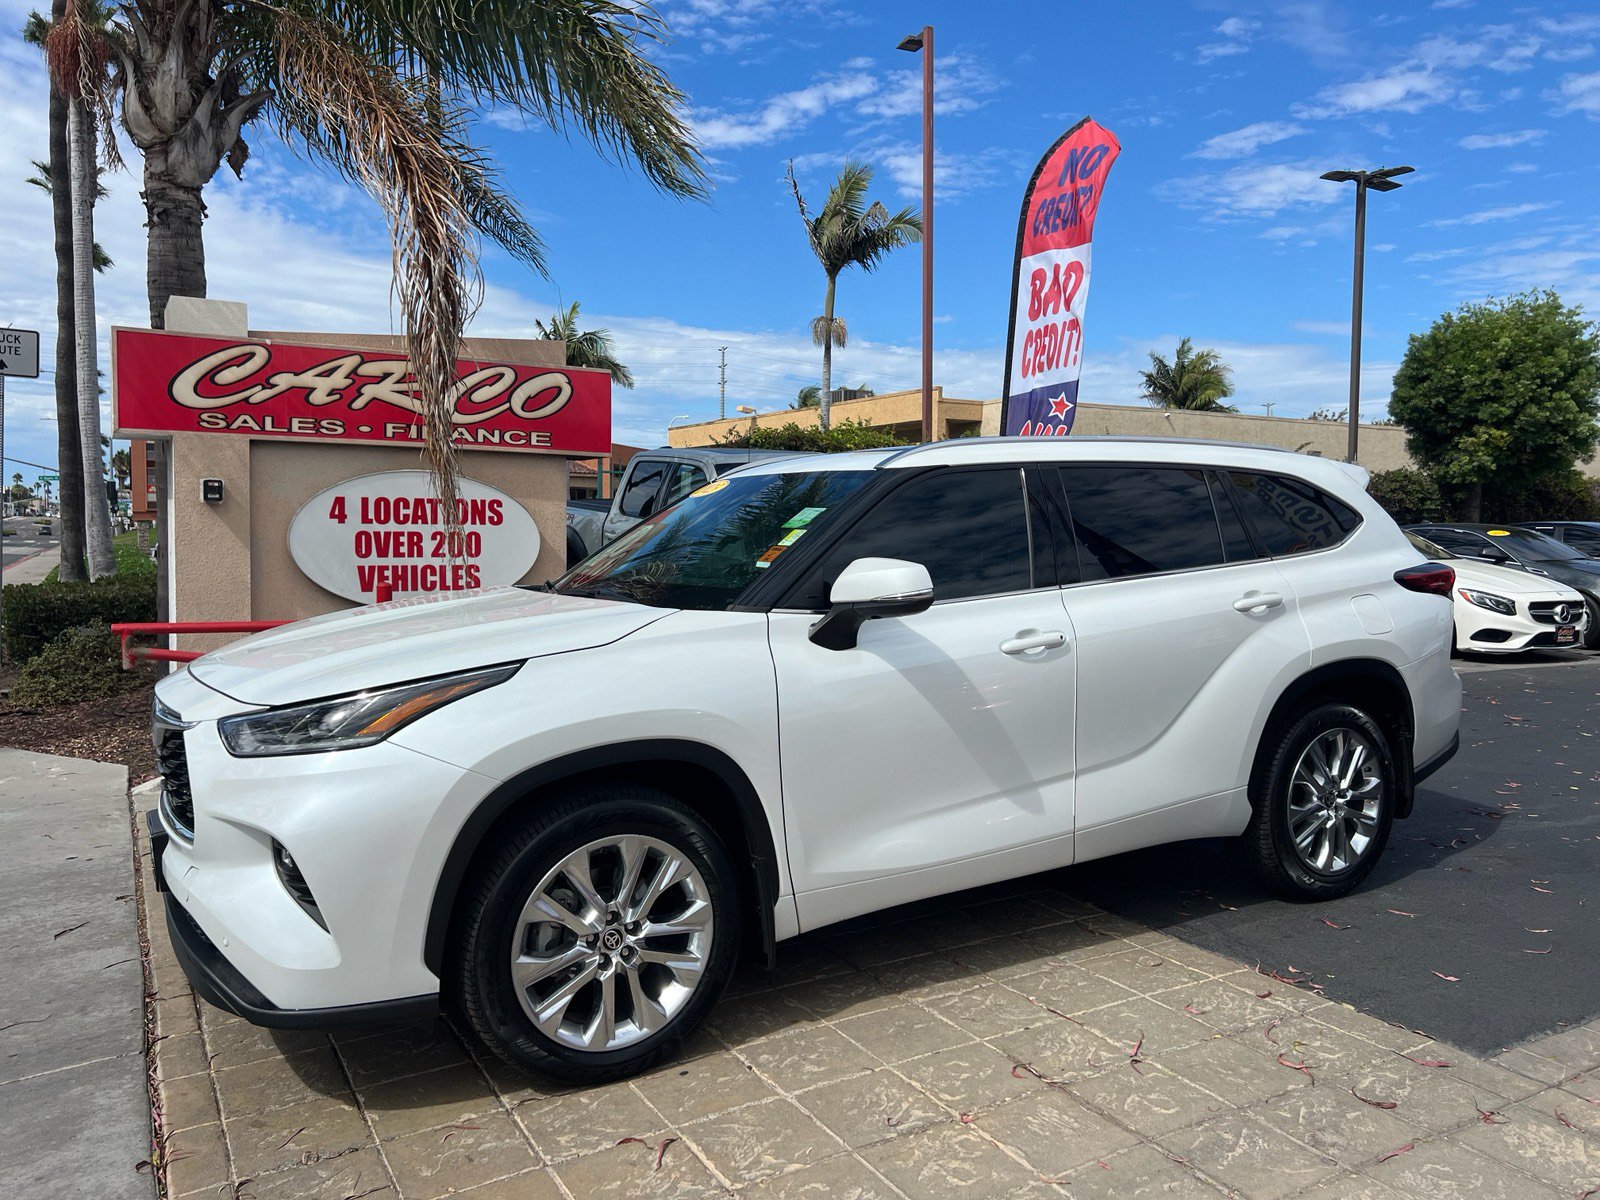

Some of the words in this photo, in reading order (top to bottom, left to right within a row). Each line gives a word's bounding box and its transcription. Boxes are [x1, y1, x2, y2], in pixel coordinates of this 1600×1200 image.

[1057, 143, 1110, 187] NO
[1033, 184, 1093, 237] CREDIT?
[1028, 260, 1084, 322] BAD
[1021, 317, 1081, 379] CREDIT?
[171, 344, 572, 421] CARCO
[198, 411, 345, 435] SALES
[385, 423, 553, 447] FIANCE
[329, 496, 347, 524] 4
[354, 530, 424, 559] OVER
[431, 530, 481, 559] 200
[357, 564, 481, 592] VEHICLES
